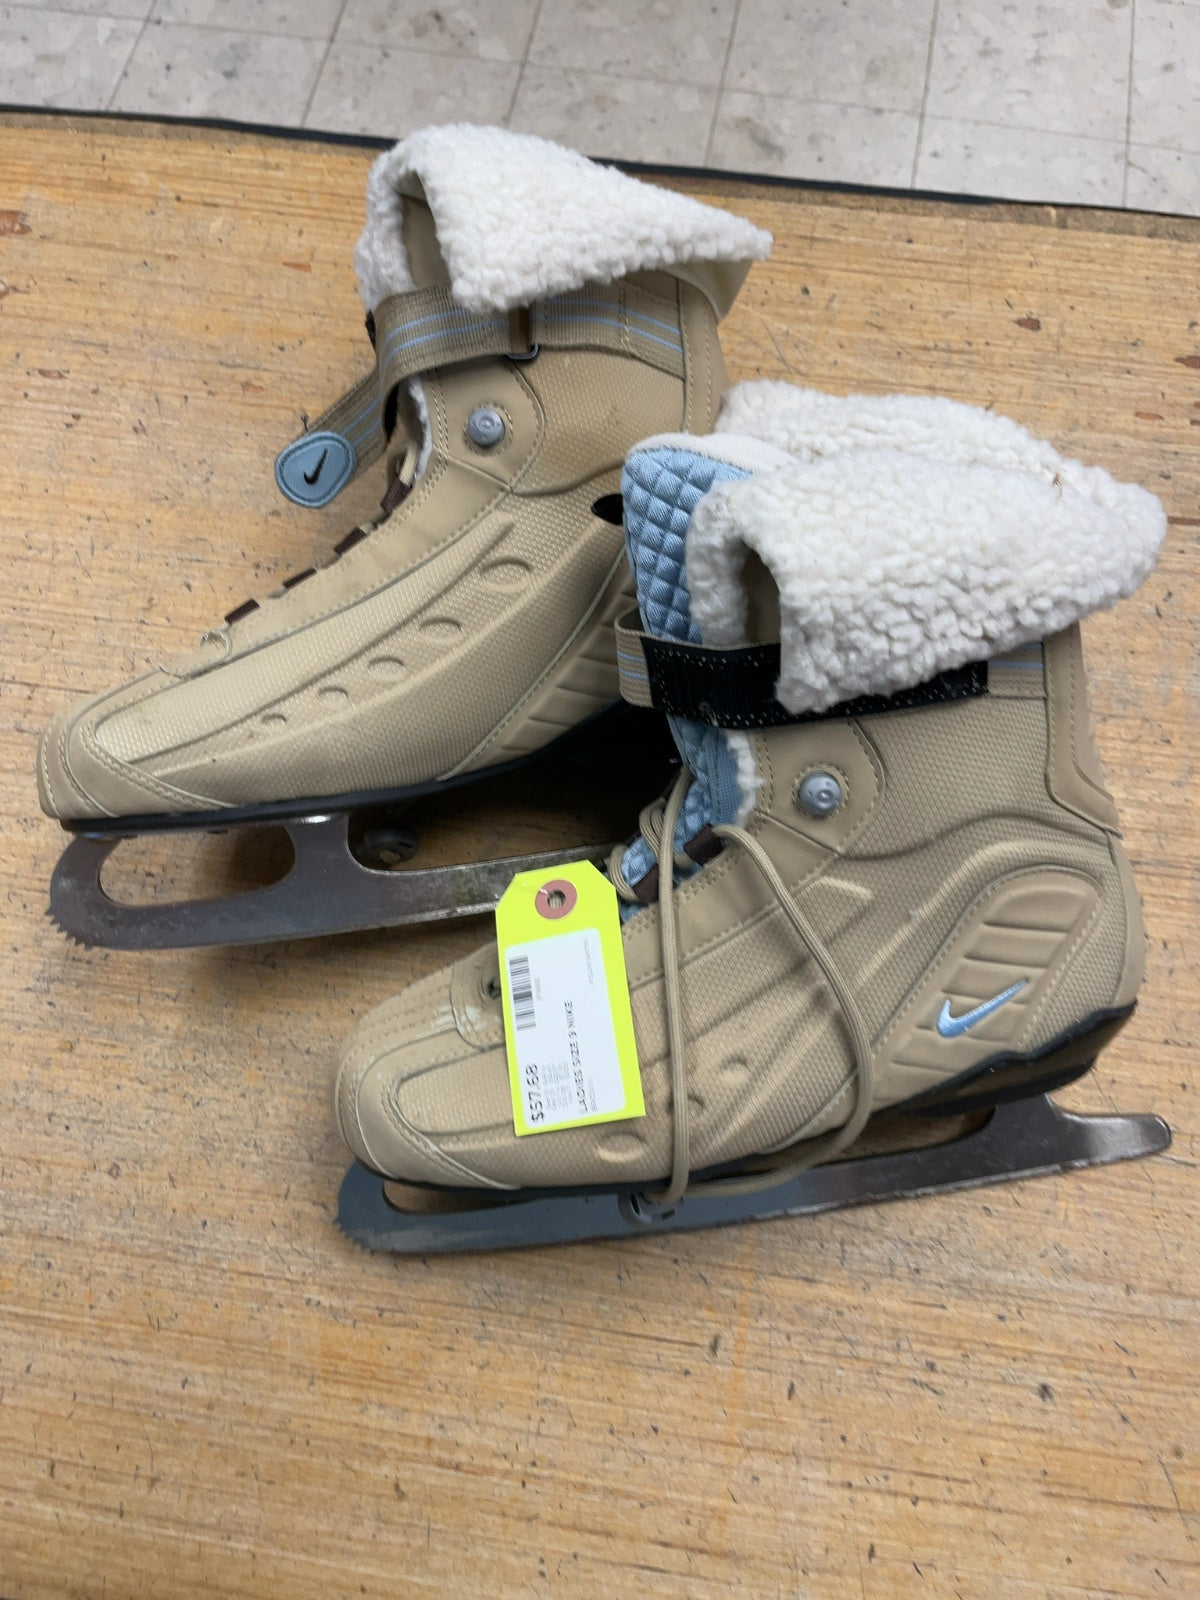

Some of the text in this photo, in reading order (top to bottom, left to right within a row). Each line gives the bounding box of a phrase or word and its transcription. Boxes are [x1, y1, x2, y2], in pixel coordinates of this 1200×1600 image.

[564, 1000, 575, 1028] NIKE
[570, 1040, 581, 1066] SIZE
[574, 1069, 588, 1113] LADIES
